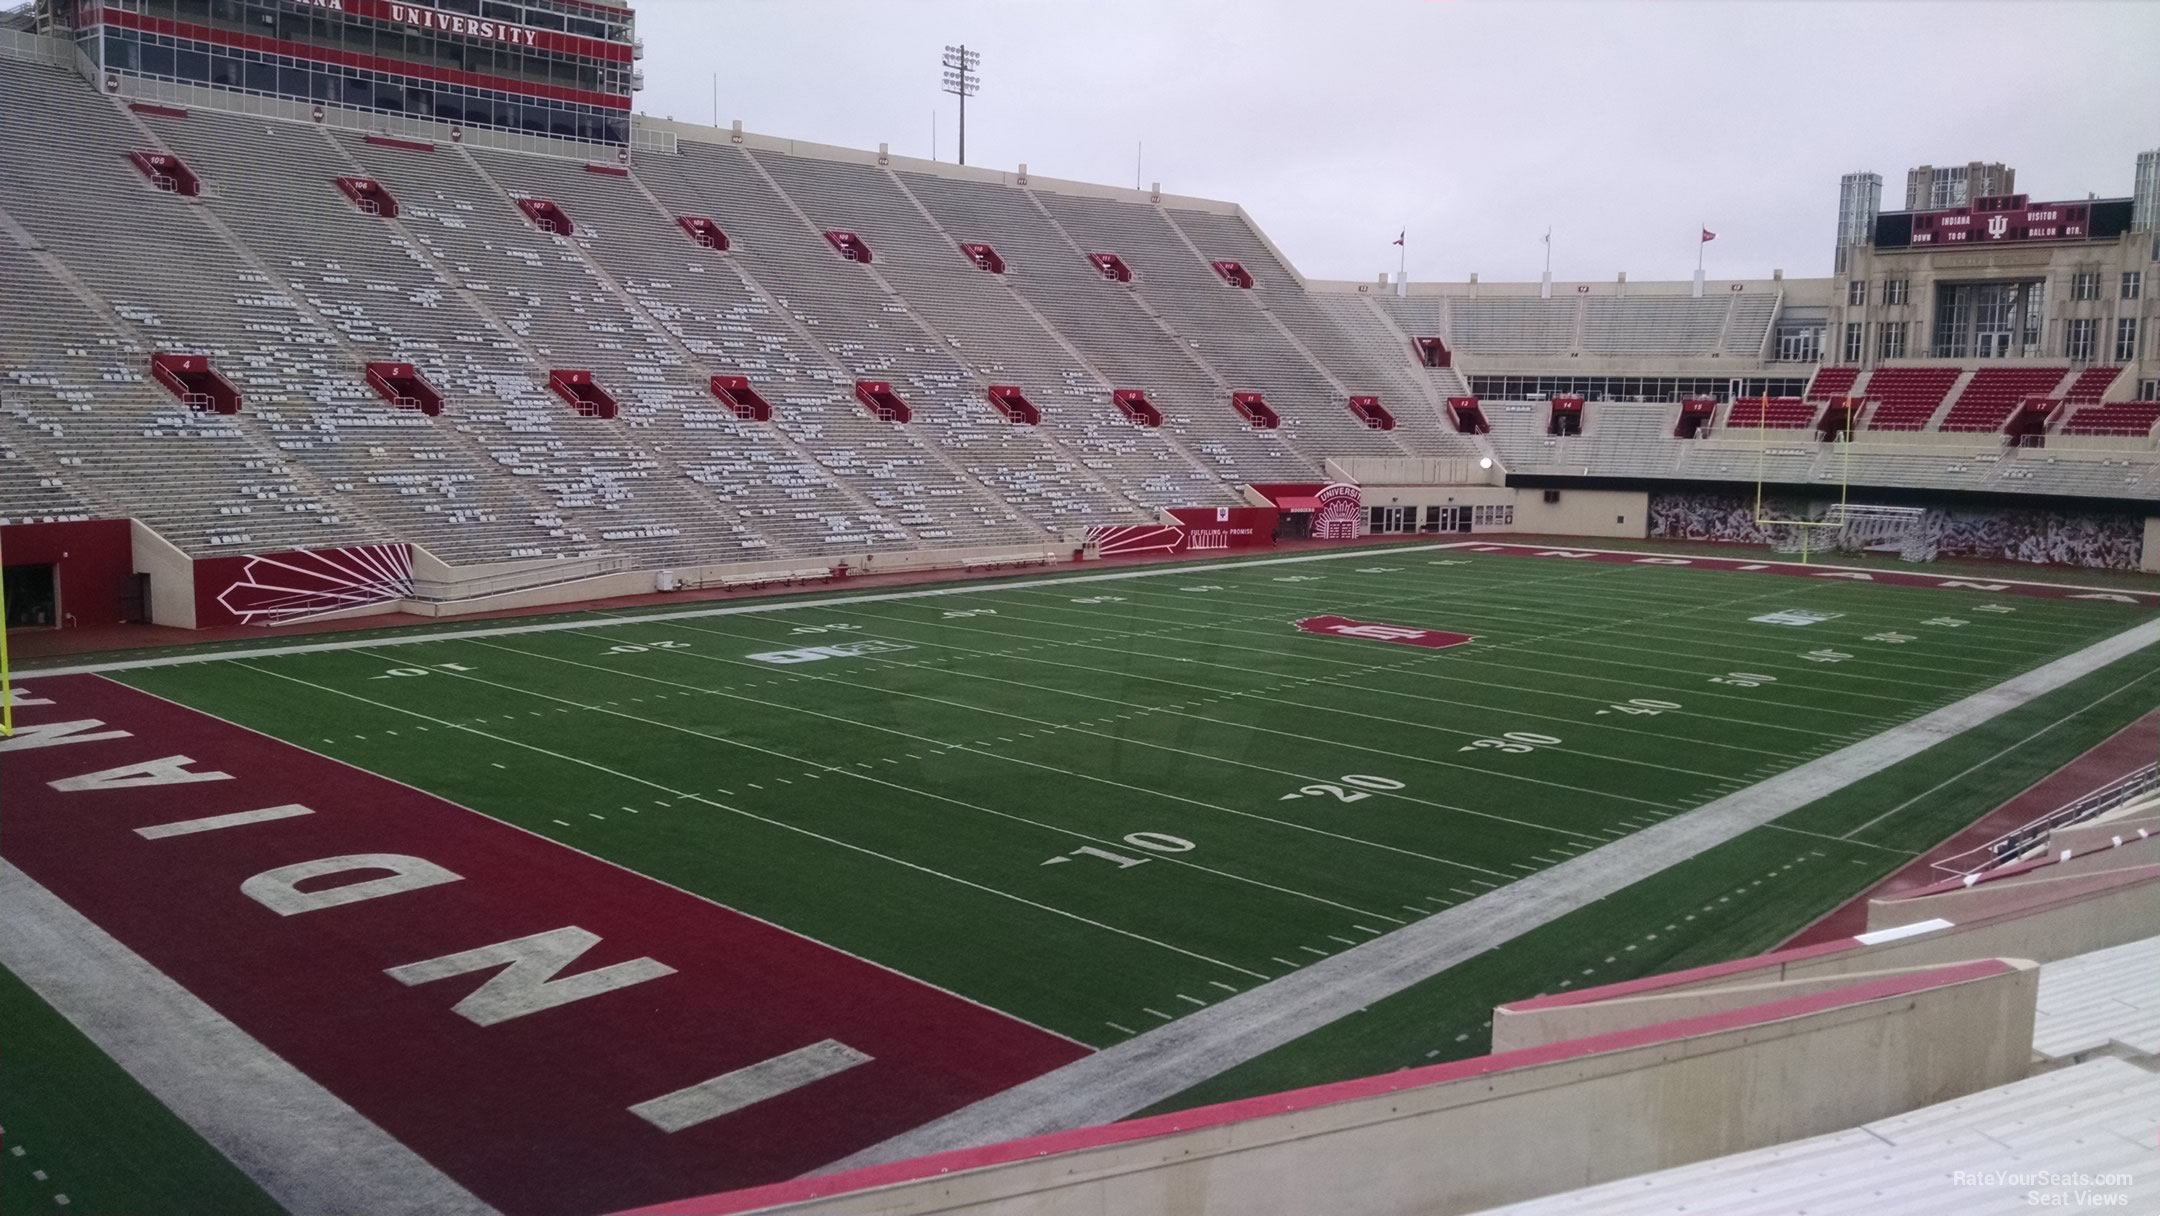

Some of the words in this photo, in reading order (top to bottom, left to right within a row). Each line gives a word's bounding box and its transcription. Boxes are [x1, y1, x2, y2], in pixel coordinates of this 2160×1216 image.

[391, 5, 537, 46] UNIVERSITY
[150, 157, 165, 165] 105
[354, 181, 368, 189] 106
[1941, 215, 1971, 226] INDIANA
[2027, 211, 2057, 222] VISITOR
[1913, 233, 1932, 242] DOWN
[1948, 233, 1957, 241] TO
[1957, 232, 1966, 240] GO
[2029, 228, 2046, 237] BALL
[183, 360, 191, 369] 4
[392, 368, 399, 376] 5
[1725, 672, 1777, 687] 50
[1609, 698, 1683, 715] 40
[1471, 731, 1563, 753] 30
[1300, 774, 1406, 803] 20
[1069, 831, 1196, 869] 10
